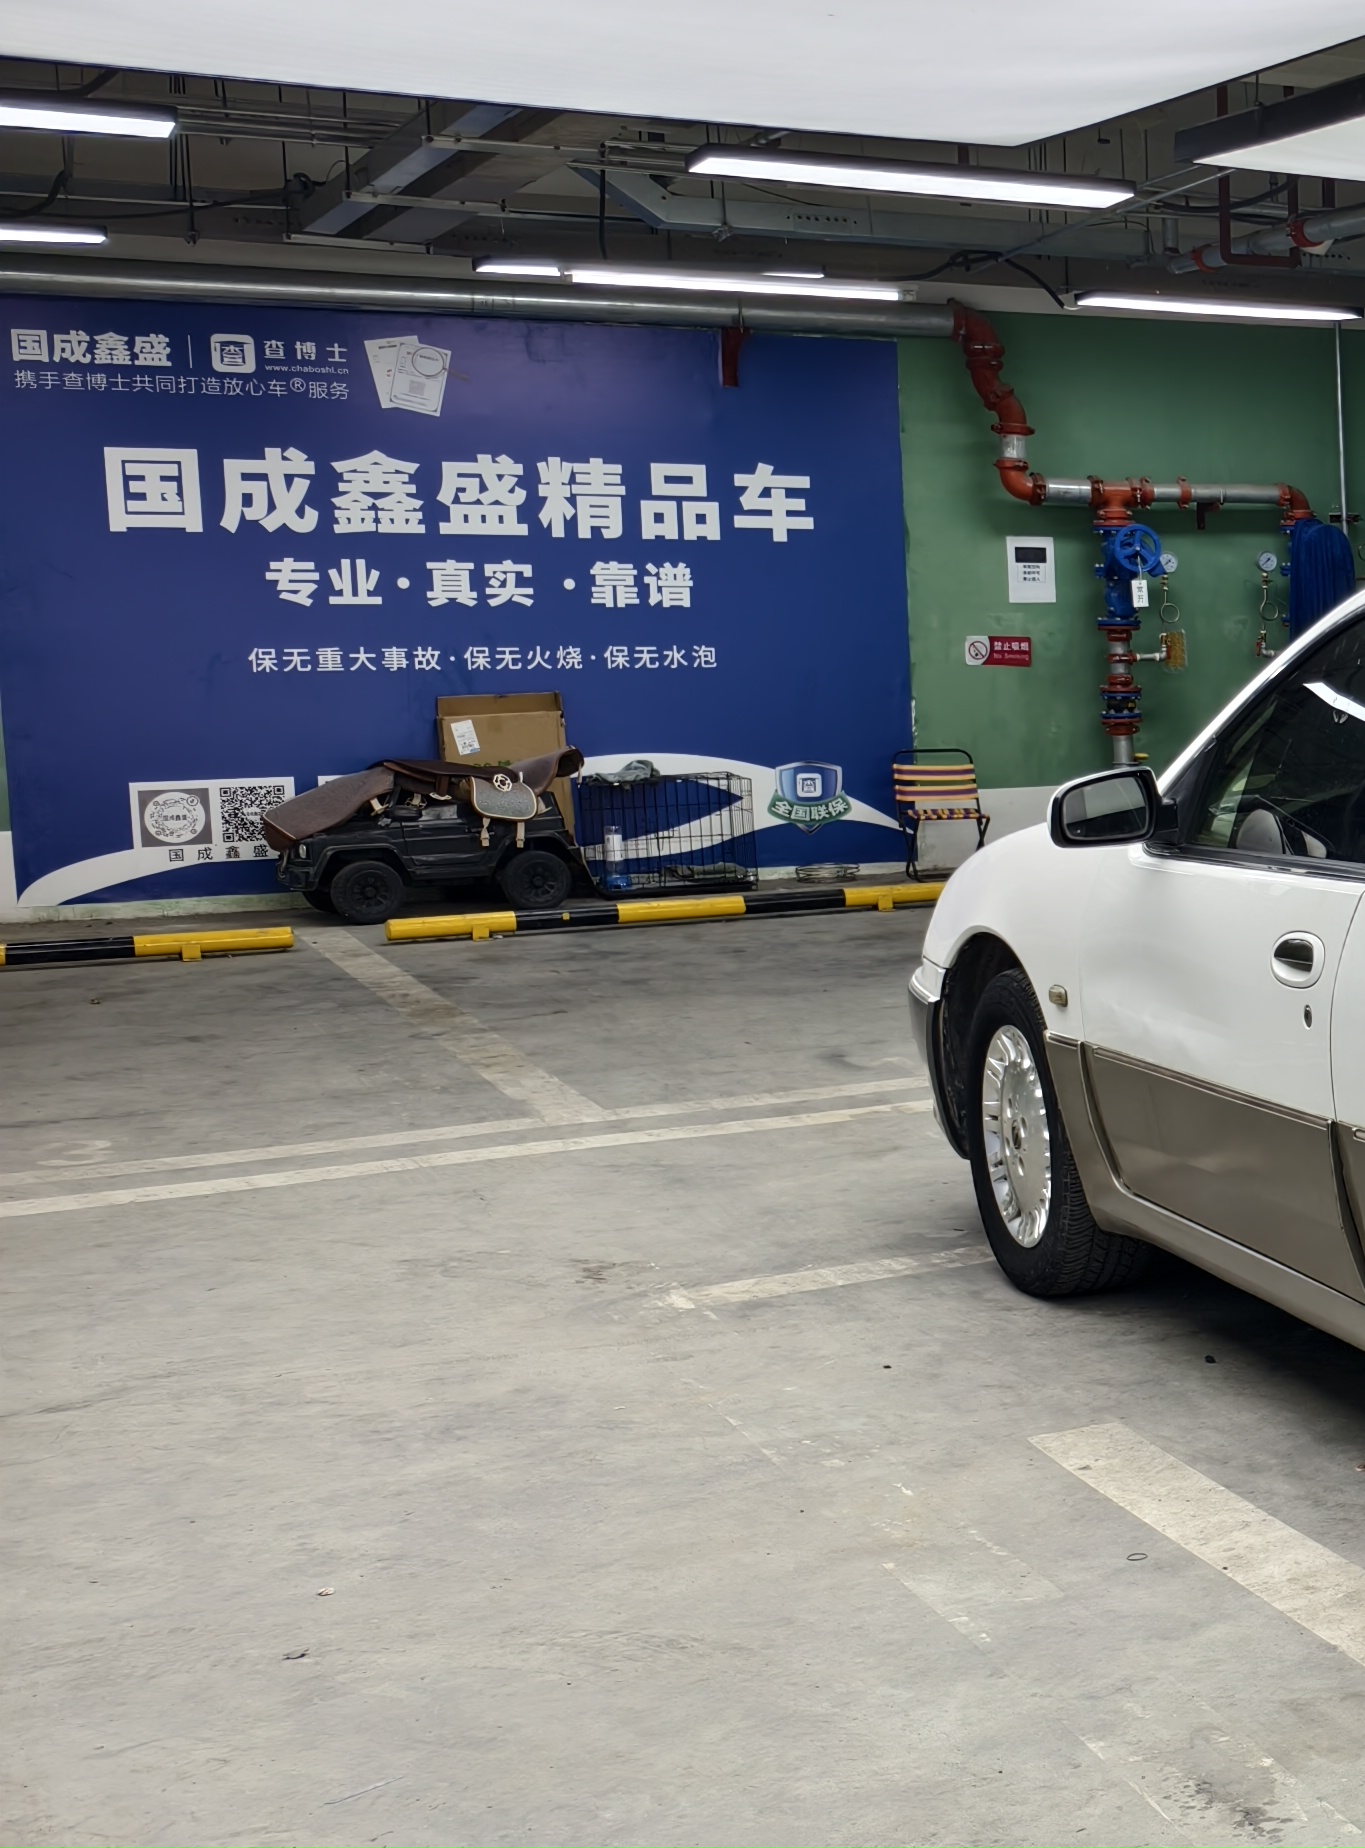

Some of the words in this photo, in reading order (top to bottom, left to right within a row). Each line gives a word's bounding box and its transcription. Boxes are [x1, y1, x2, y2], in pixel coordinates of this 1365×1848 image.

[11, 329, 172, 367] 国成鑫盛
[264, 340, 348, 362] 查博士
[104, 446, 815, 543] 国成鑫盛精品车
[771, 797, 849, 821] 全国联保
[168, 844, 269, 863] 国成鑫盛
